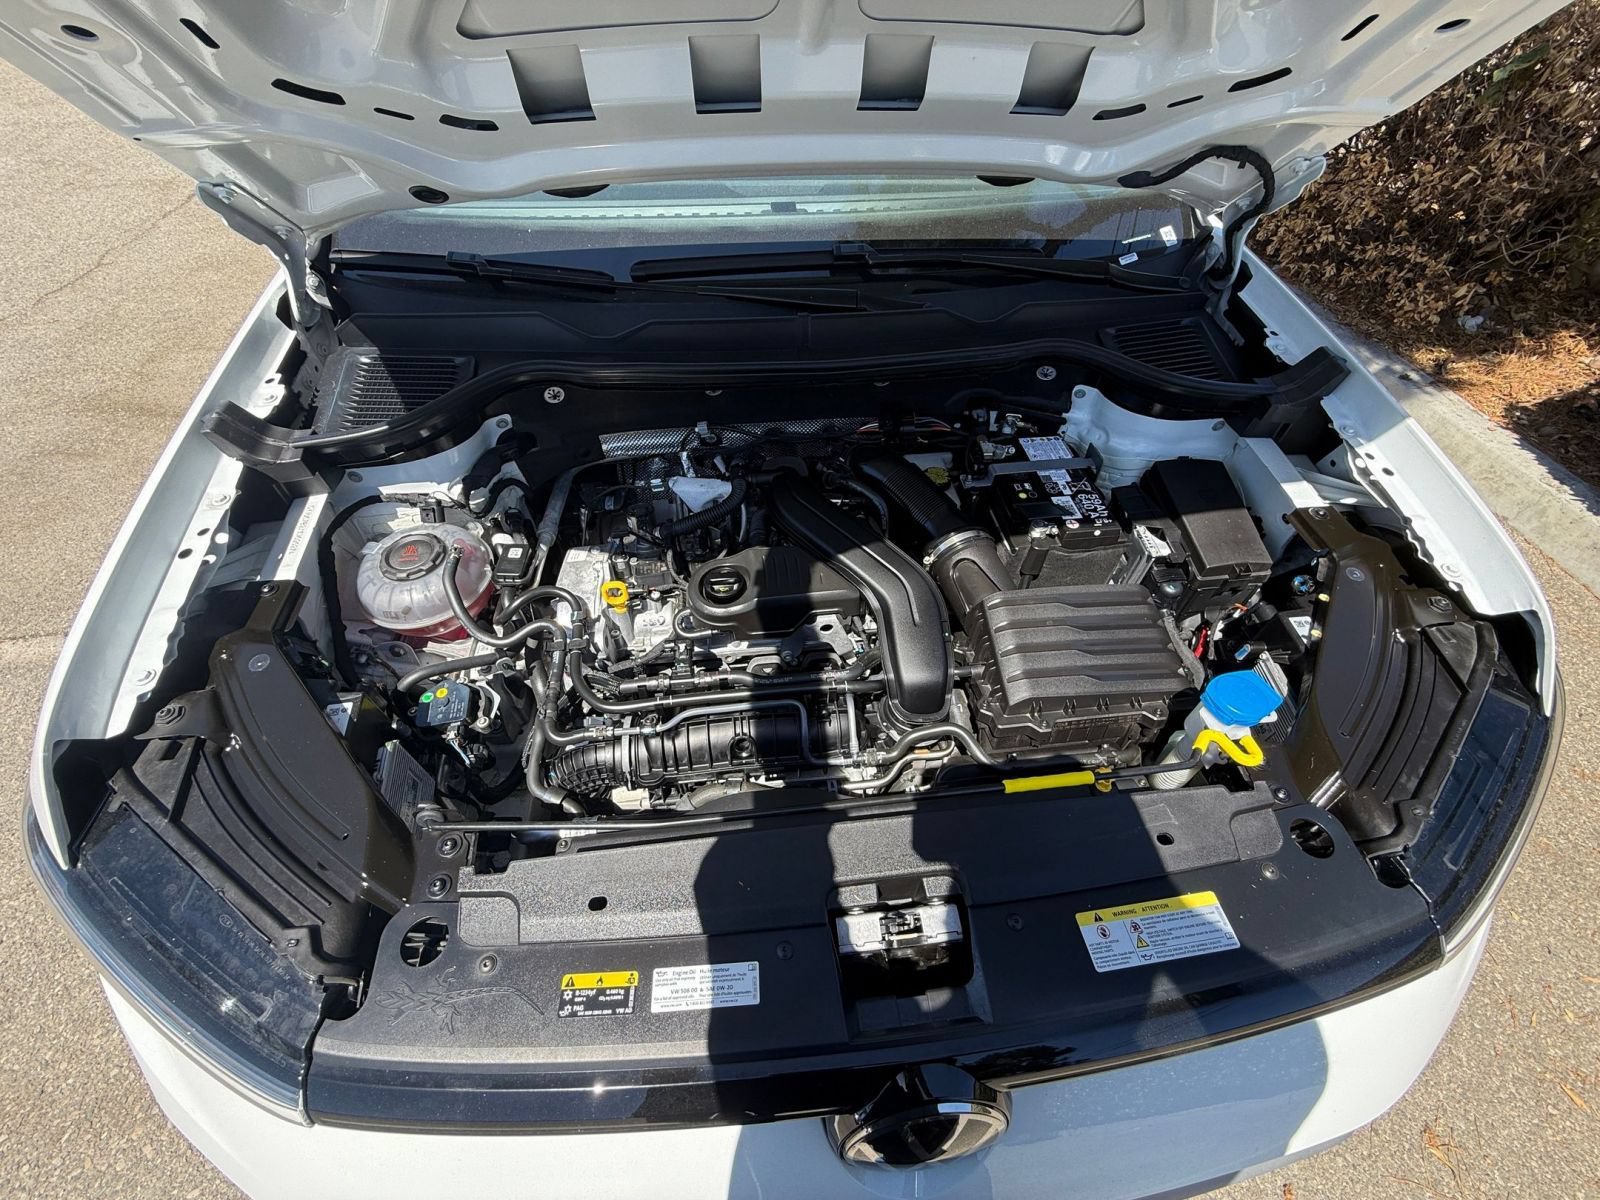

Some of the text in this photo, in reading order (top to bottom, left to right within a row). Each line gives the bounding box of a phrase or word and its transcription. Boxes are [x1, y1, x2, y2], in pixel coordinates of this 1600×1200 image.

[1078, 494, 1094, 510] 640
[1088, 494, 1108, 517] 59Ah
[1112, 908, 1137, 918] WARNING
[1141, 903, 1170, 913] ATTENTION
